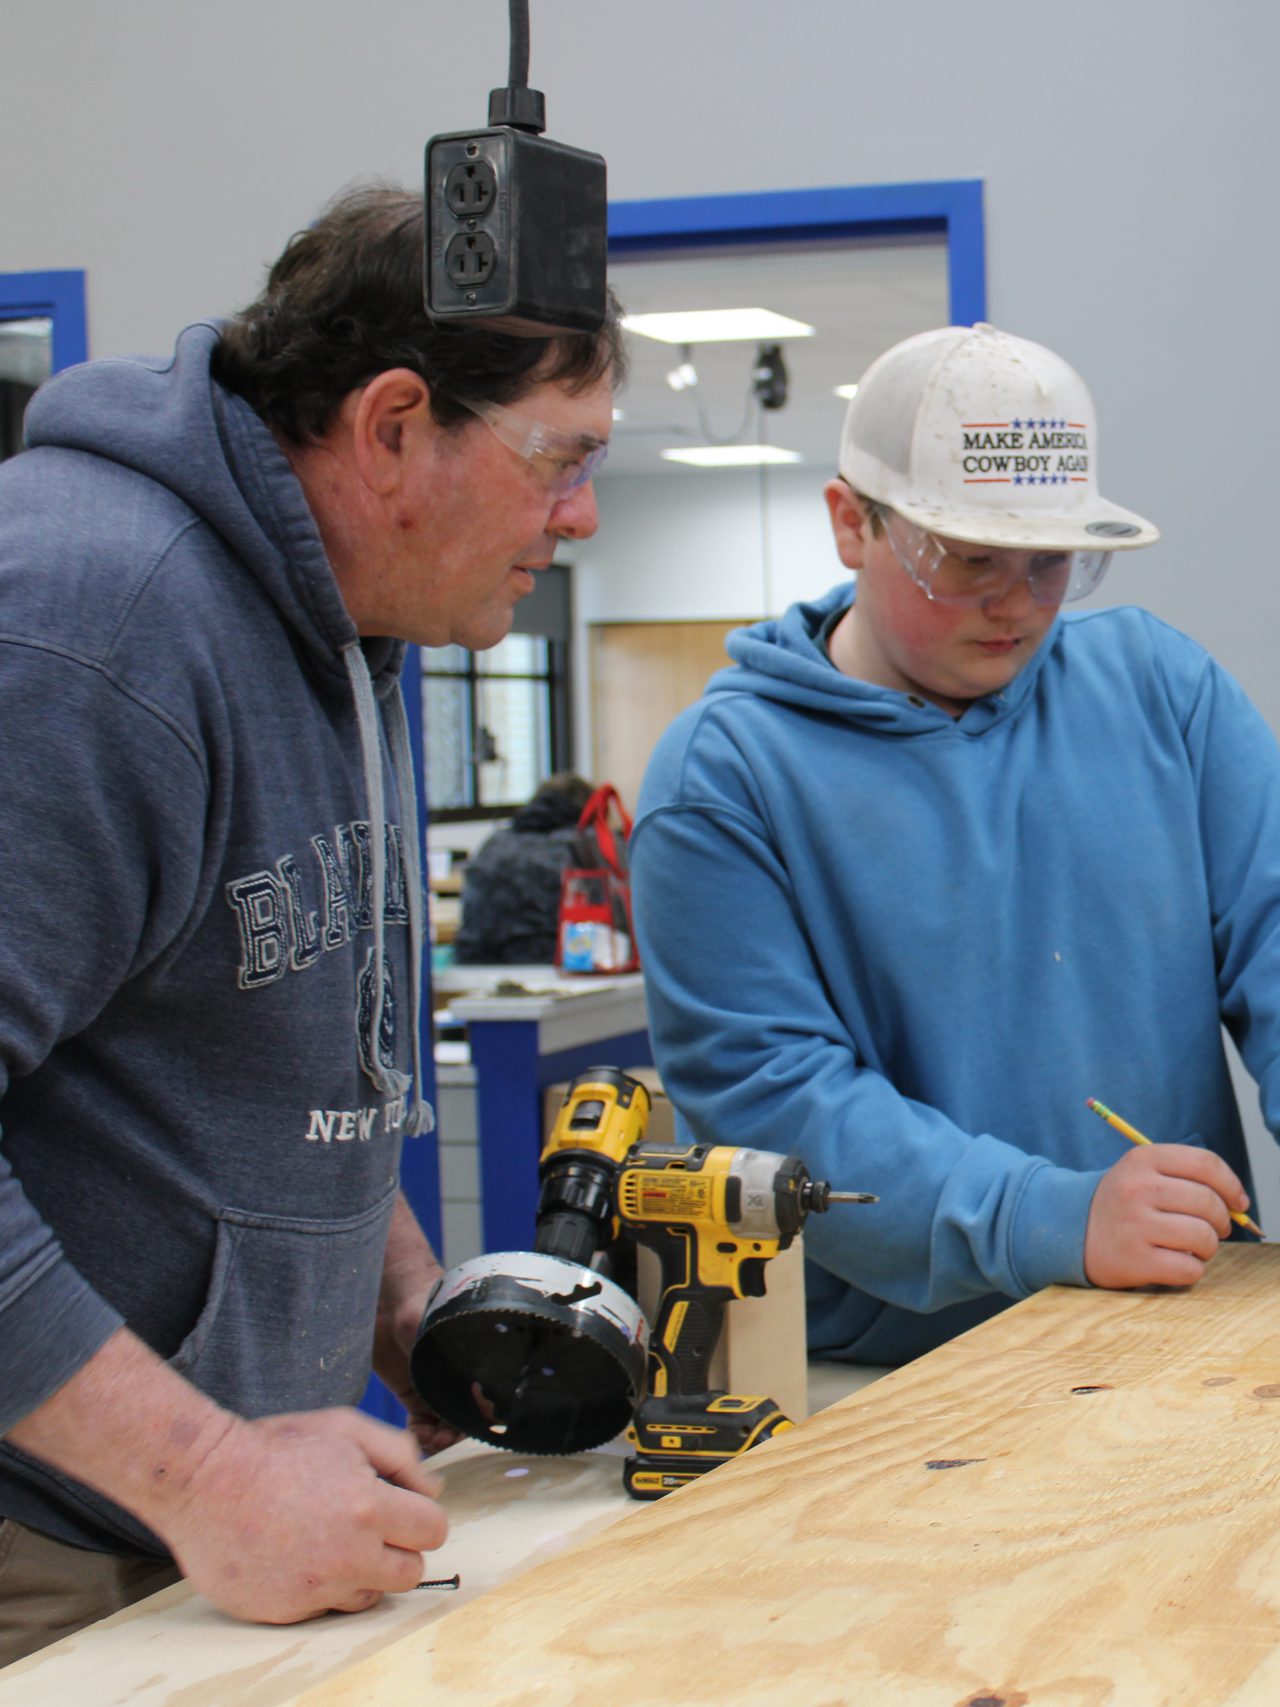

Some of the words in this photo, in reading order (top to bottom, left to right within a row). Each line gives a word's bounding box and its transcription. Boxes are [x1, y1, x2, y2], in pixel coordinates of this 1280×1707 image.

[963, 432, 1023, 450] MAKE
[963, 455, 1050, 473] COWBOY
[305, 1105, 378, 1143] NEW
